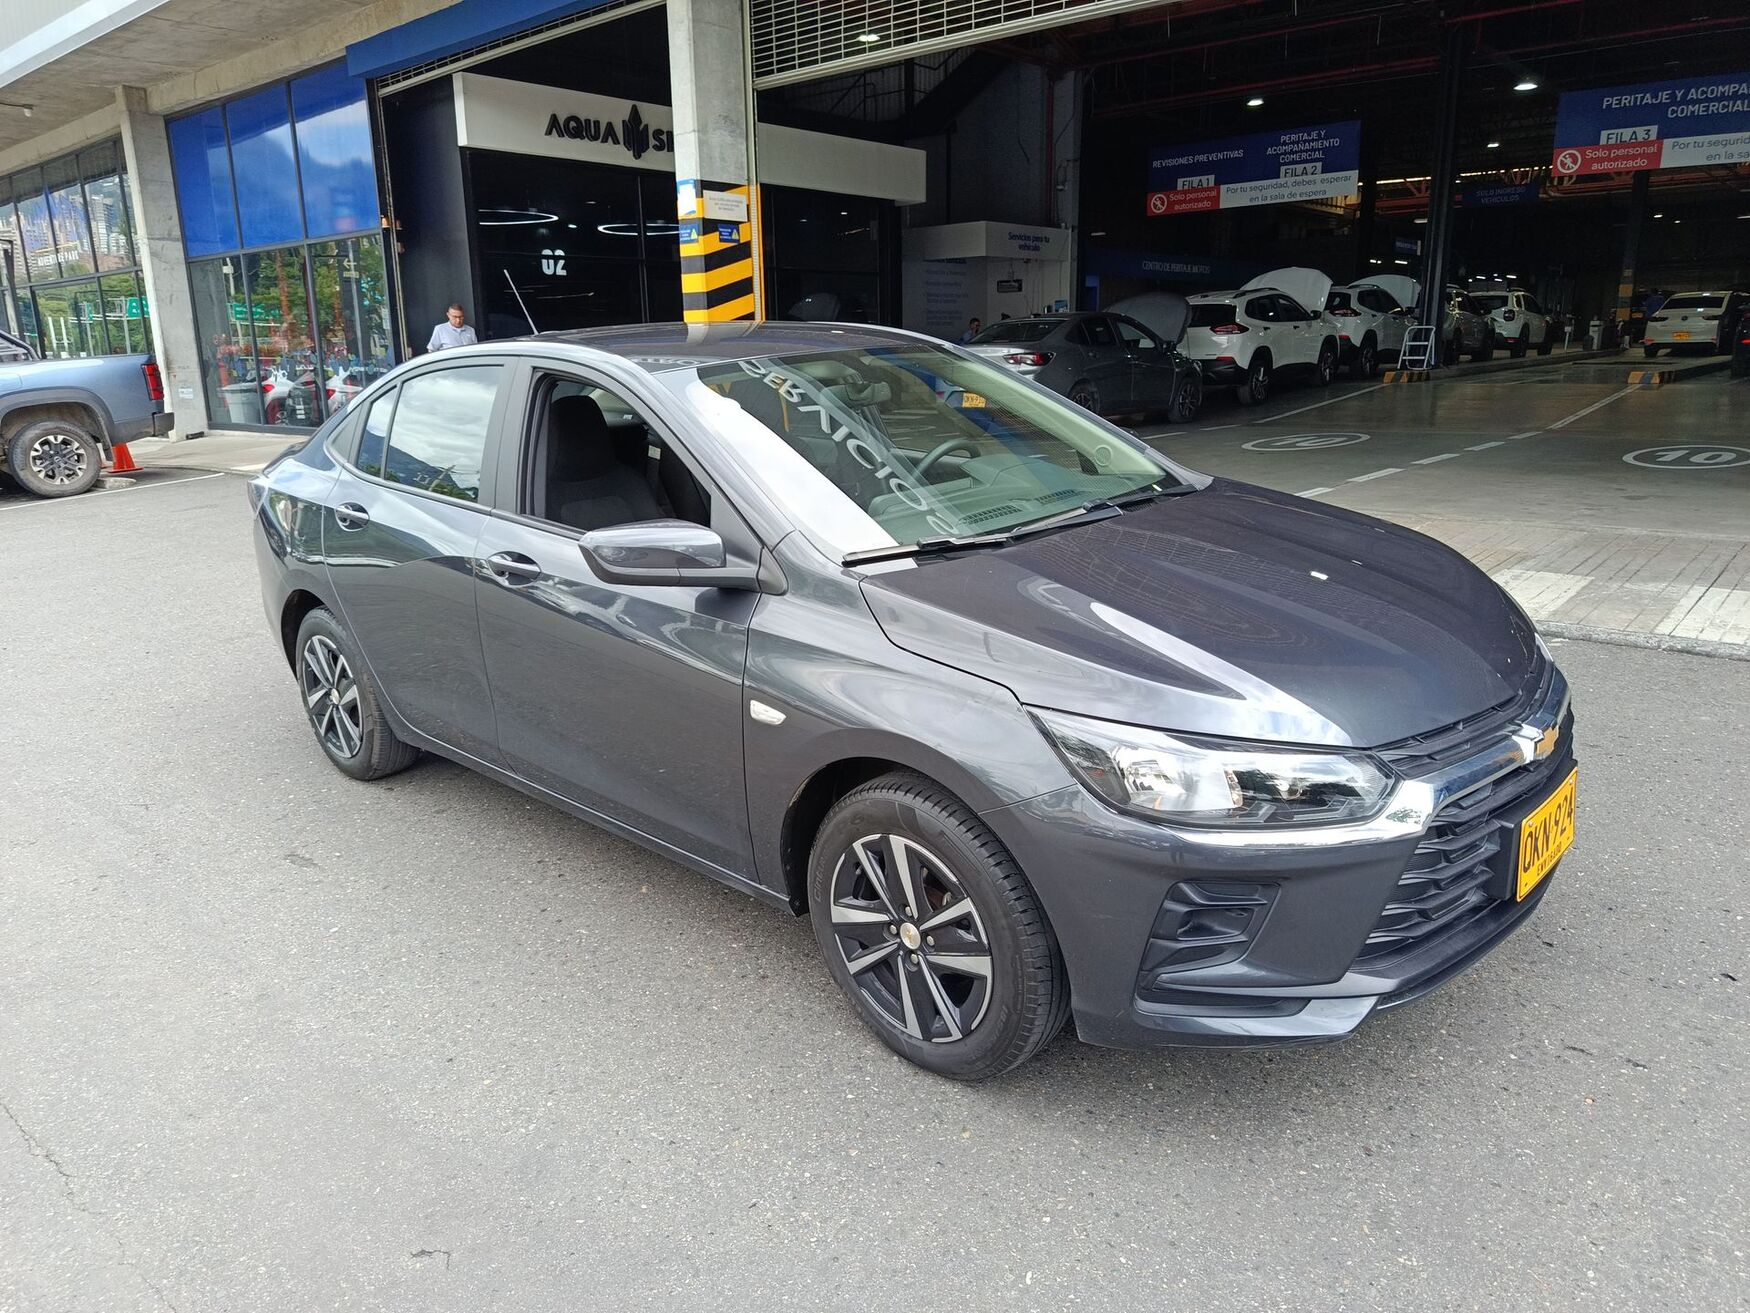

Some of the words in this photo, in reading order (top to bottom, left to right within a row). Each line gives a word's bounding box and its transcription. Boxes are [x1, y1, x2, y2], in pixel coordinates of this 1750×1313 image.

[1602, 90, 1672, 109] PERITAJE
[1675, 89, 1684, 101] Y
[1686, 83, 1750, 100] ACOMPA
[1667, 99, 1750, 118] COMERCIAL
[545, 113, 621, 145] AQUA
[1280, 130, 1318, 143] PERITAJE
[1320, 130, 1326, 138] Y
[1606, 131, 1638, 144] FILA
[1642, 129, 1651, 140] 3
[1266, 138, 1340, 155] ACOMPAÑAMIENTO
[1585, 149, 1608, 159] Solo
[1611, 144, 1657, 158] personal
[1672, 141, 1690, 150] Por
[1152, 155, 1194, 168] REVISIONES
[1194, 149, 1244, 163] PREVENTIVAS
[1279, 151, 1325, 163] COMERCIAL
[1706, 153, 1720, 161] en
[1724, 151, 1734, 160] la
[1591, 158, 1648, 170] autorizado
[1284, 167, 1308, 178] FILA
[1310, 165, 1318, 175] 2
[1181, 179, 1203, 190] FILA
[1226, 186, 1239, 194] Por
[1249, 182, 1290, 193] seguridad,
[1291, 178, 1317, 187] debes
[1320, 175, 1352, 185] esperar
[1169, 193, 1185, 202] Solo
[1186, 189, 1217, 200] personal
[1269, 193, 1286, 201] sala
[1287, 191, 1298, 199] de
[1299, 188, 1327, 199] espera
[1174, 200, 1212, 210] autorizado
[541, 249, 567, 276] 02
[1655, 450, 1737, 463] 10
[1553, 786, 1574, 846] 924
